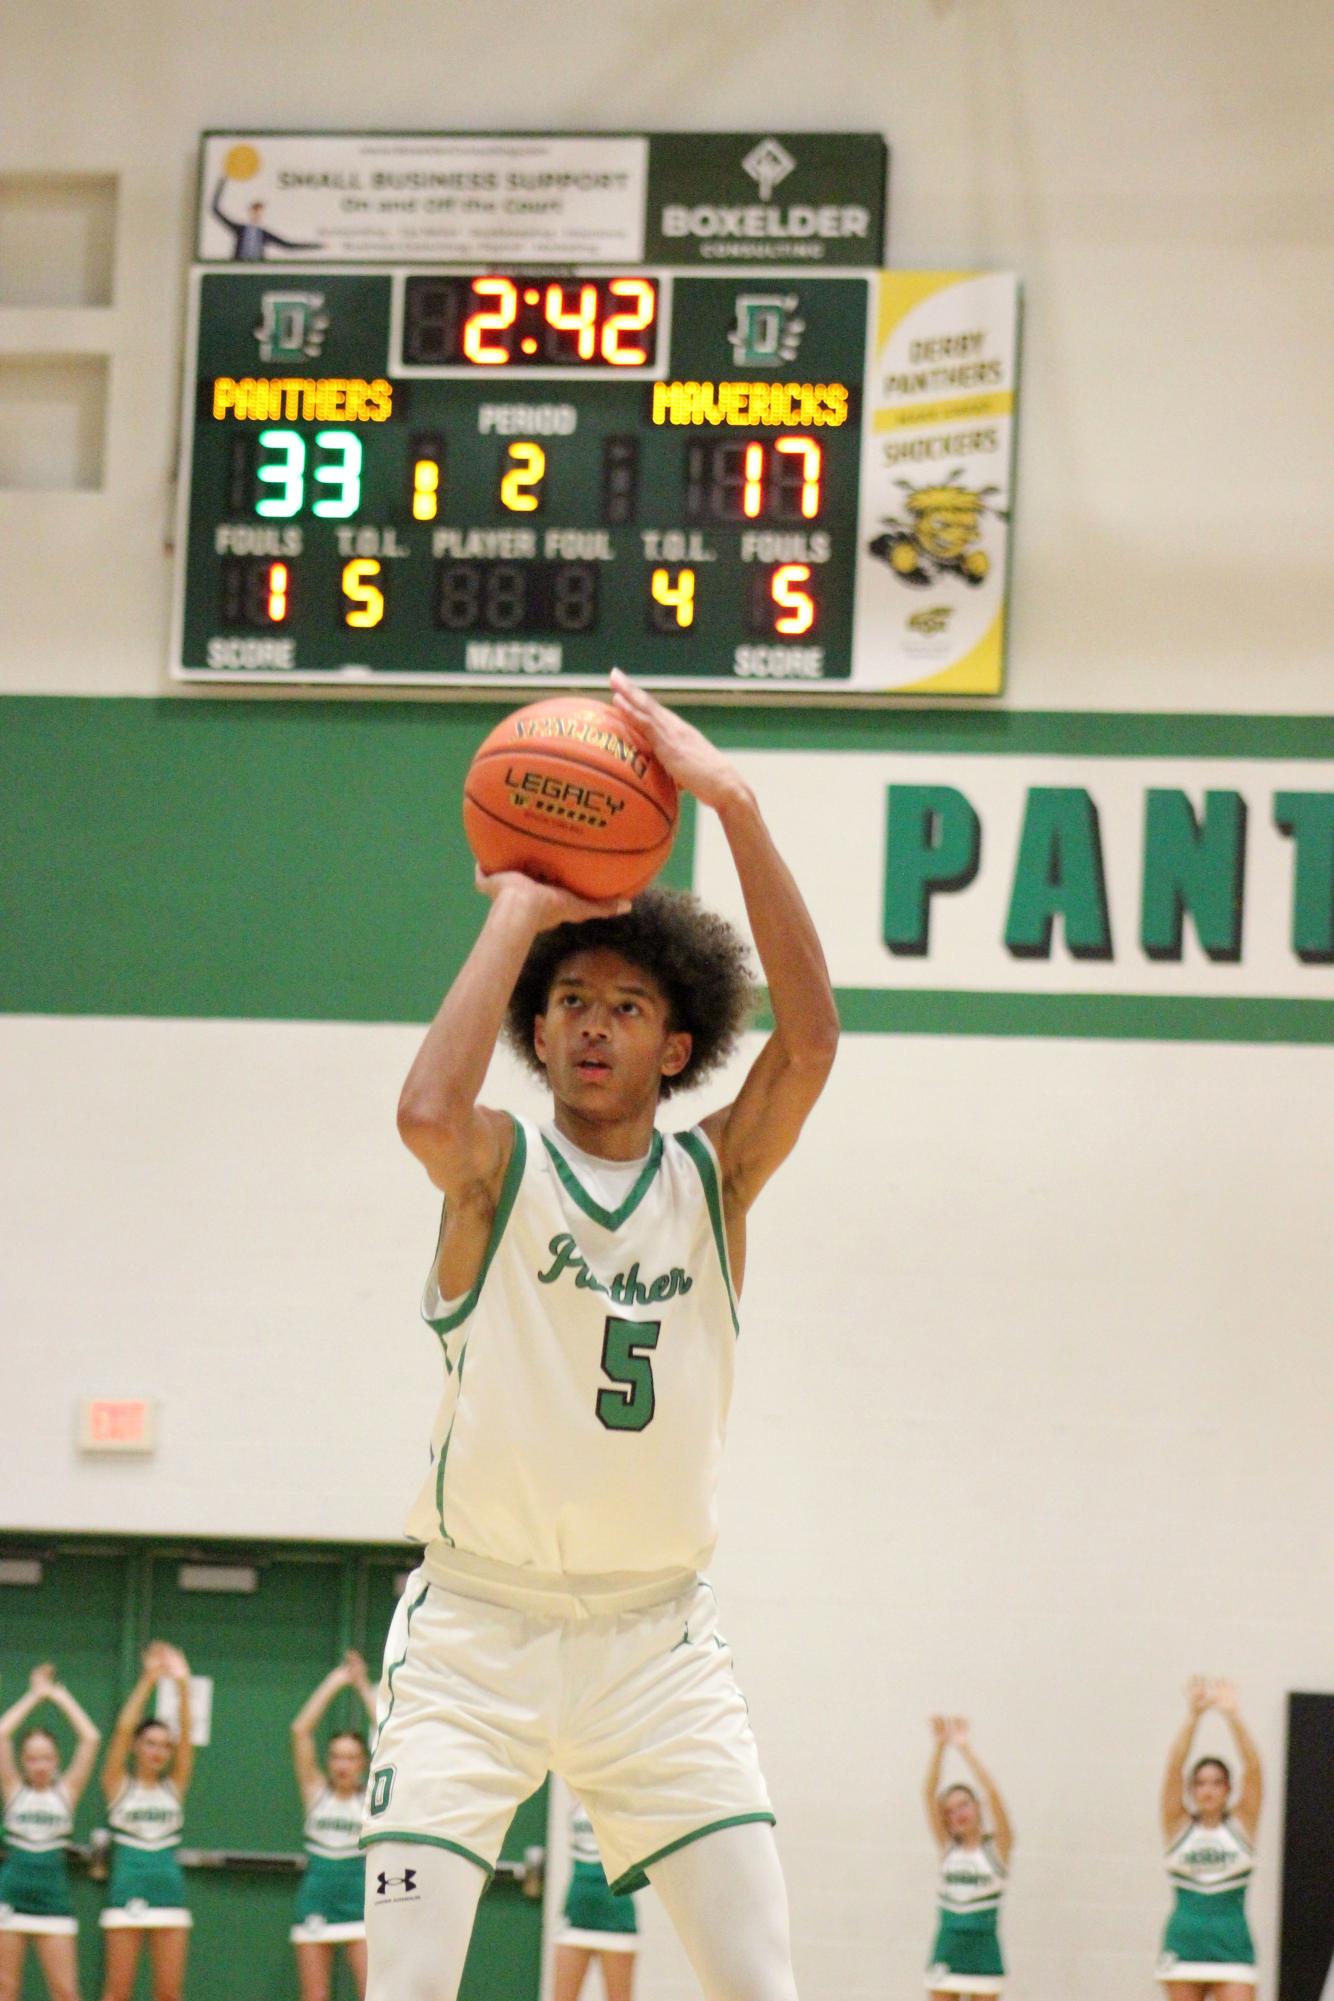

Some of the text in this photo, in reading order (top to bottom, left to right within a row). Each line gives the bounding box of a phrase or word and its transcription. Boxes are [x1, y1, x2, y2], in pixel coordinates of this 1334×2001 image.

[371, 171, 497, 191] BUSINESS
[505, 172, 628, 191] SUPPORT
[661, 204, 870, 239] BOXELDER
[463, 276, 655, 366] 2:42
[910, 331, 984, 364] DERBY
[213, 377, 393, 422] PANTHERS
[884, 360, 1003, 396] PANTHERS
[478, 403, 577, 435] PERIOD
[652, 381, 848, 427] MAVERICKS
[255, 429, 363, 519] 33
[501, 441, 545, 512] 2
[743, 436, 822, 519] 17
[215, 523, 304, 557] FOULS
[432, 527, 615, 561] PLAYER FOUL
[741, 531, 831, 563] FOULS
[267, 561, 288, 622] 1
[341, 557, 384, 628] 5
[651, 567, 695, 628] 4
[771, 563, 815, 635] 5
[205, 637, 298, 670] SCORE
[466, 641, 562, 673] MATCH
[732, 644, 824, 678] SCORE
[504, 766, 626, 816] LEGACY
[595, 1315, 661, 1432] 5
